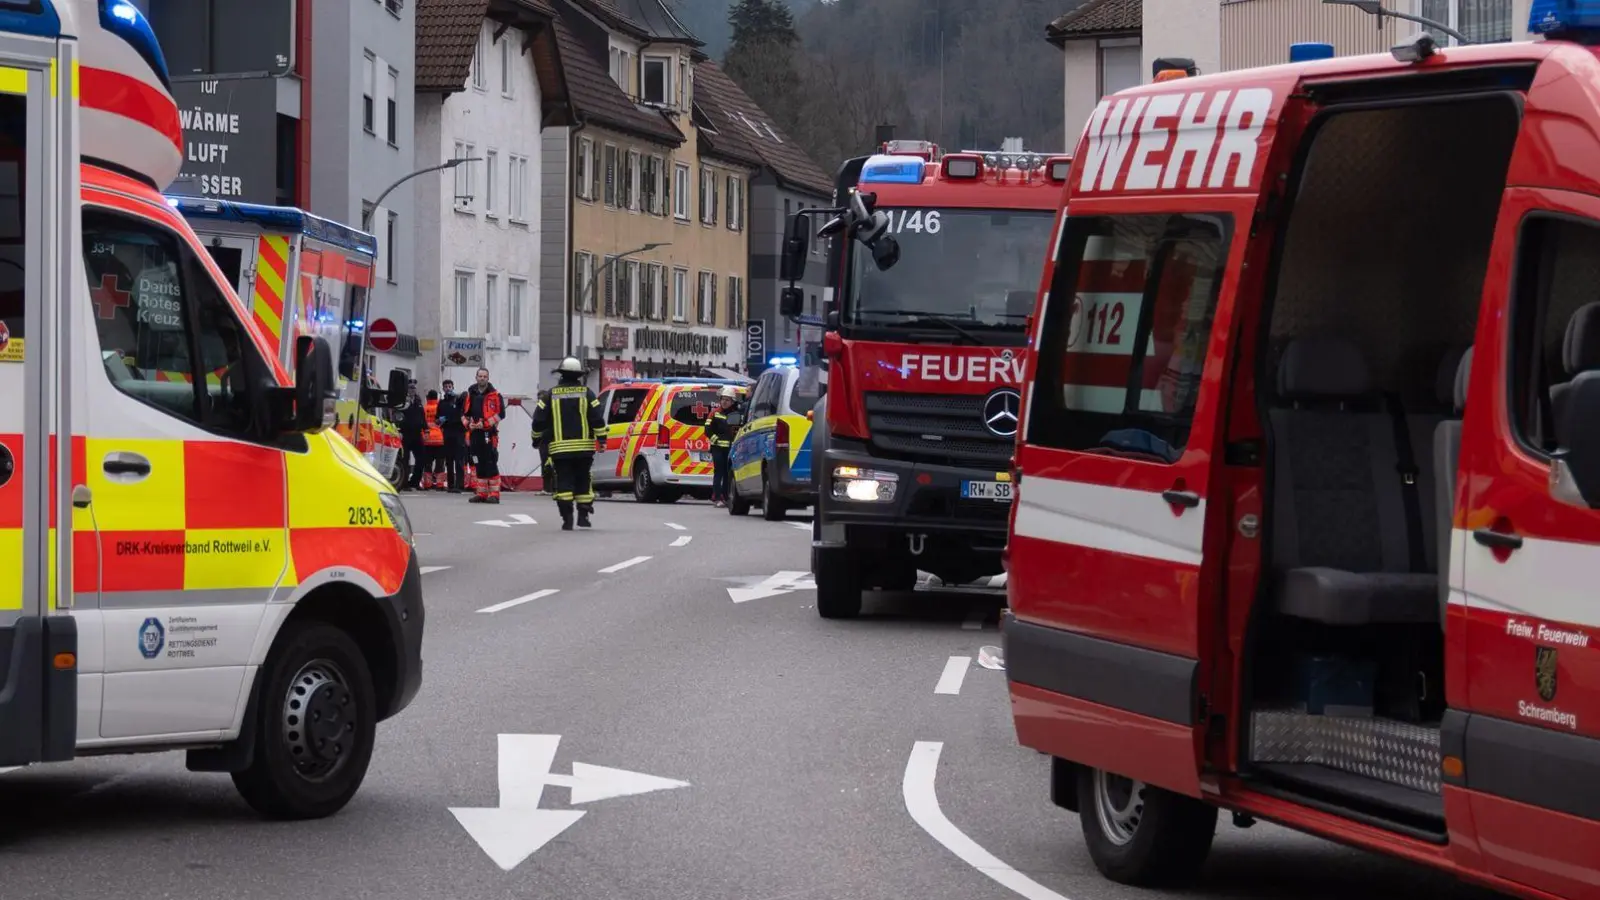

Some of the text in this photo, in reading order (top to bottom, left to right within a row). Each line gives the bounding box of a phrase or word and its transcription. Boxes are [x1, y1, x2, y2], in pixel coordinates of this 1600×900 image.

[179, 106, 239, 133] WÄRME
[1079, 88, 1273, 192] WEHR
[188, 142, 228, 164] LUFT
[178, 172, 242, 196] SSER
[138, 293, 181, 312] Rotes
[136, 309, 180, 326] Kreuz
[1086, 301, 1125, 345] 112
[448, 340, 483, 350] Favori
[748, 325, 763, 360] TOTO
[970, 482, 1010, 496] RW SB
[348, 506, 384, 525] 2/83-1
[116, 539, 271, 556] DRK-Kreisverband Rottweil e.V.
[1506, 619, 1589, 647] Freiw. Feuerwehr
[1519, 700, 1576, 729] Schramberg
